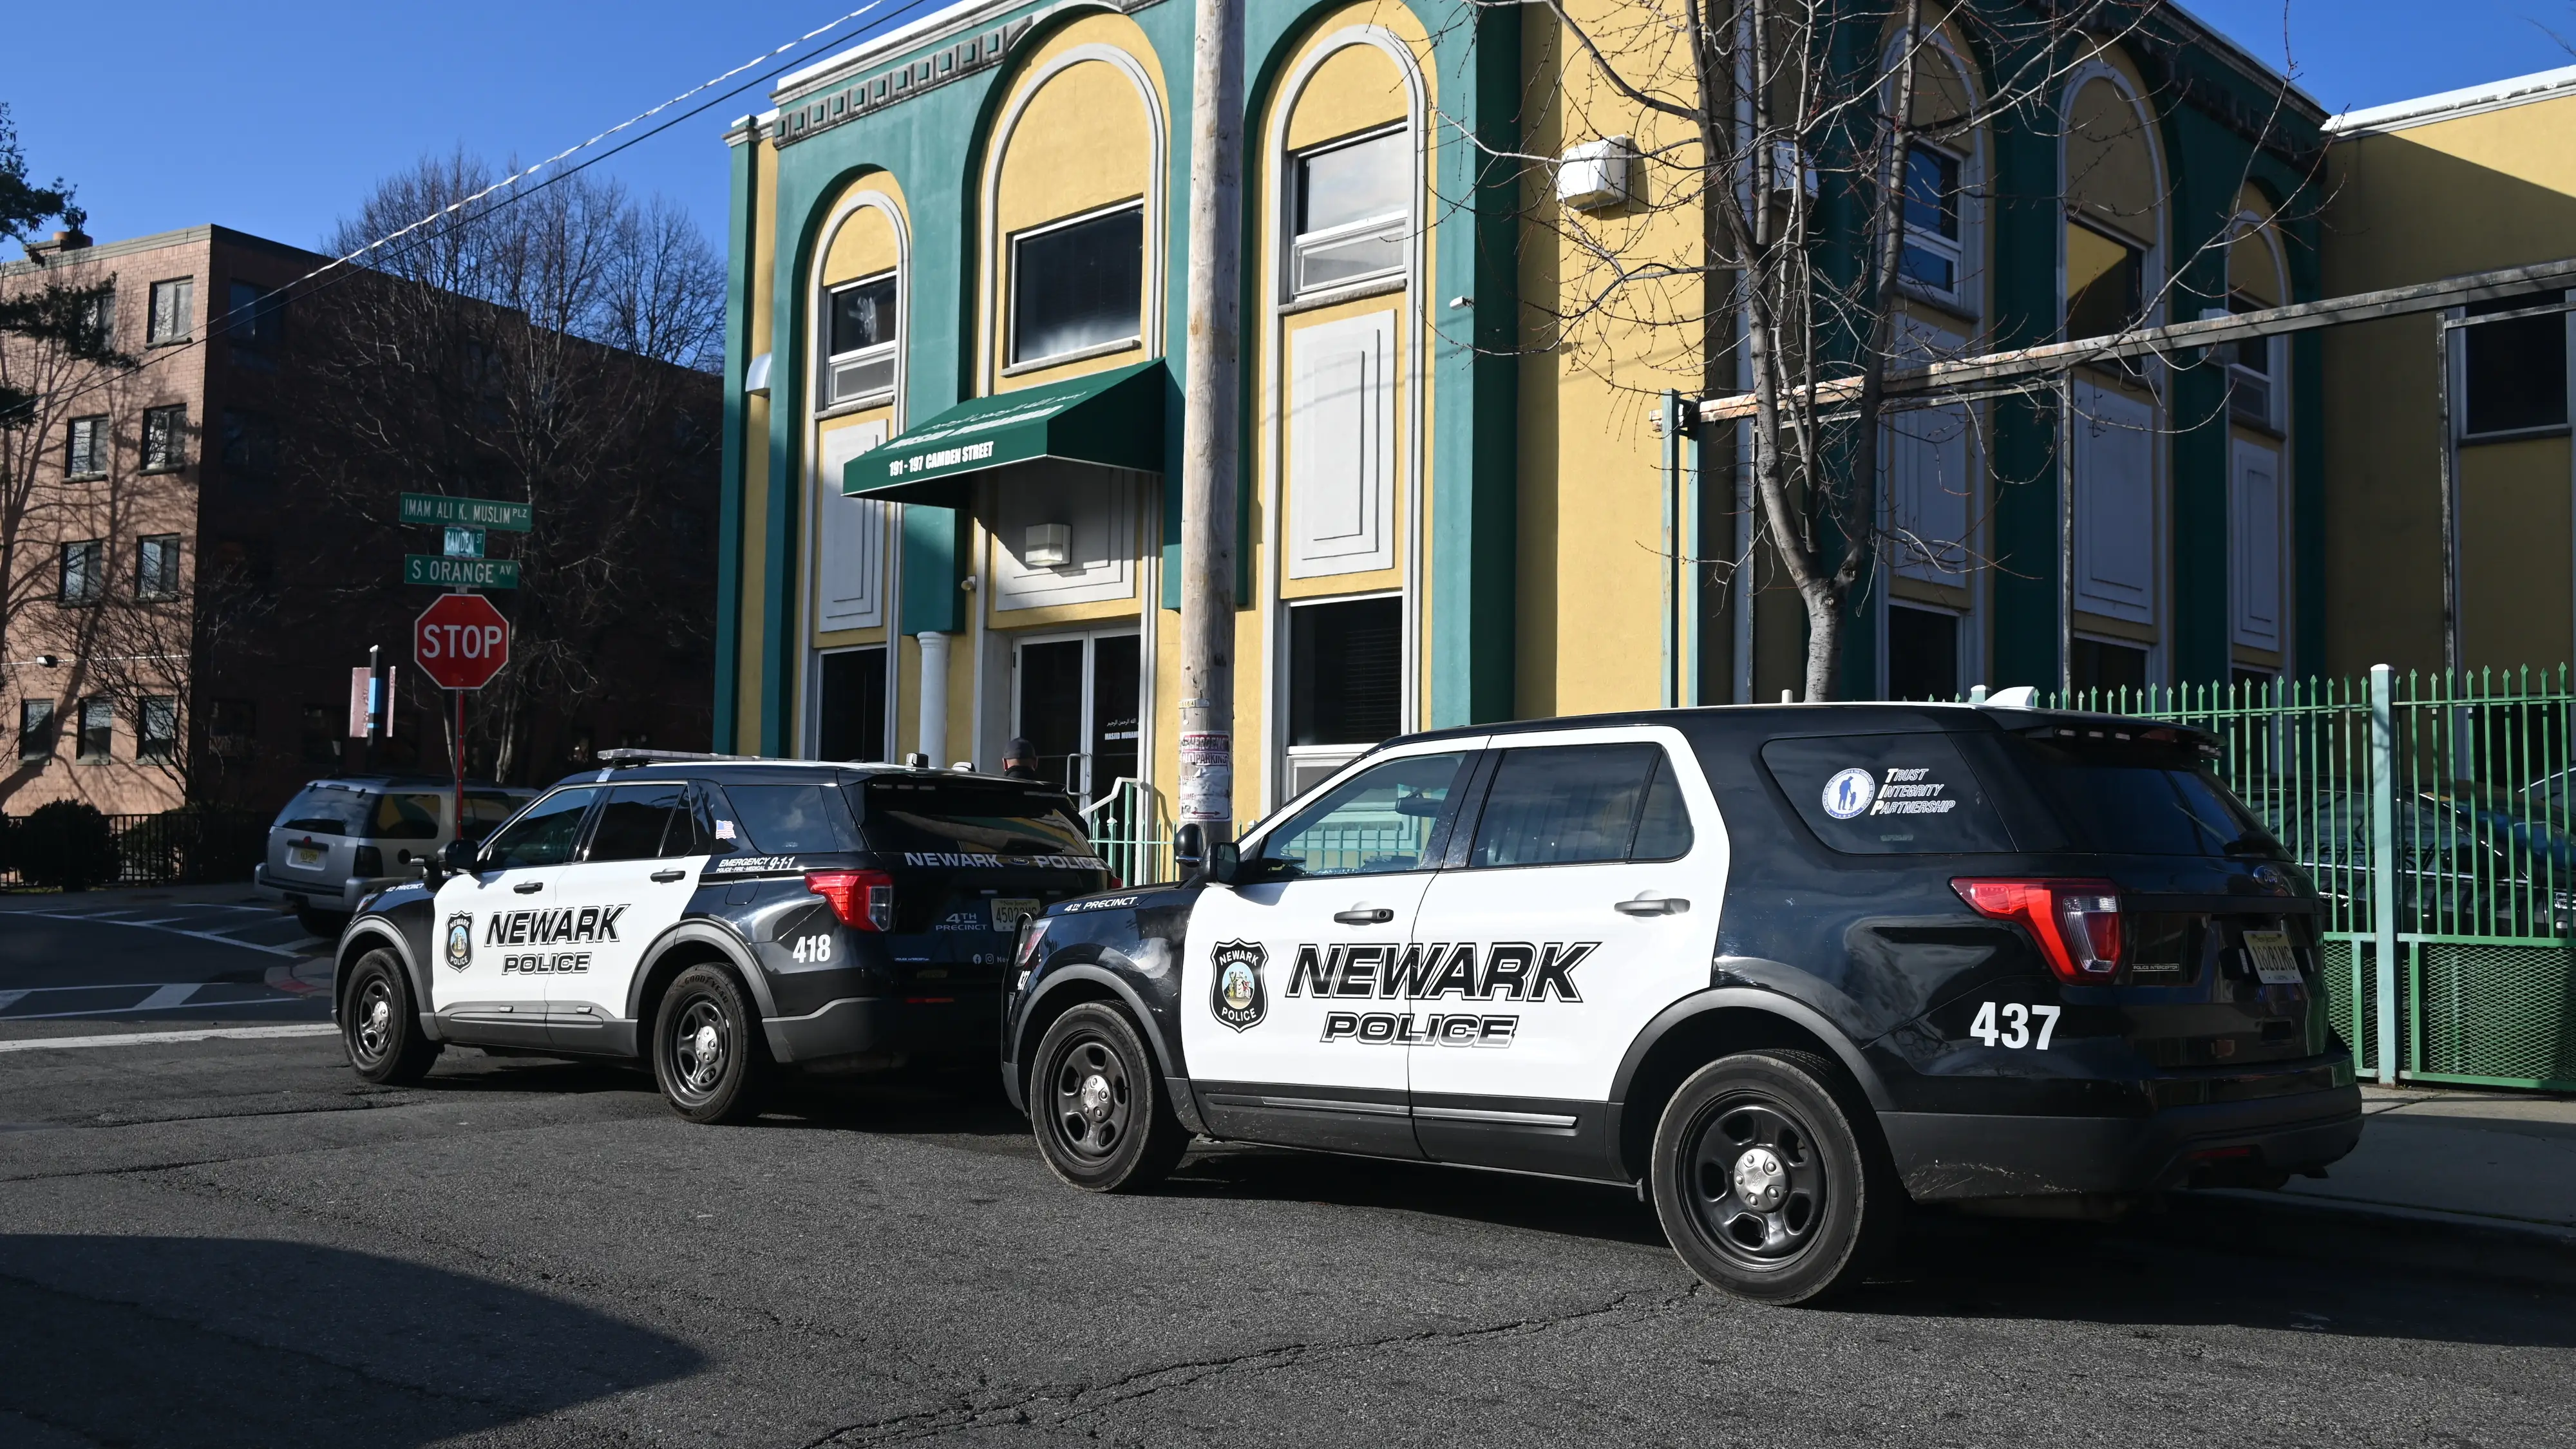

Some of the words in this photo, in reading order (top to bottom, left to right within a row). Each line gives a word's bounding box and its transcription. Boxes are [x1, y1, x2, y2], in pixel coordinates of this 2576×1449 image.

[889, 459, 904, 477] 191
[909, 455, 923, 473] 197
[925, 447, 961, 469] CAMDEN
[961, 440, 994, 462] STREET
[405, 498, 431, 517] IMAM
[437, 502, 453, 519] ALI
[459, 504, 467, 520] K.
[473, 505, 510, 524] MUSLIM
[513, 508, 527, 518] PLZ
[446, 531, 474, 553] CAMDEN
[477, 533, 483, 544] ST
[412, 560, 421, 580] S
[430, 560, 494, 583] ORANGE
[499, 565, 511, 575] AV
[422, 624, 502, 659] STOP
[1196, 753, 1228, 764] PARKING
[1885, 768, 1929, 782] TRUST
[1877, 784, 1944, 799] INTEGRITY
[1870, 800, 1956, 816] PARTNERSHIP
[719, 857, 772, 867] EMERGENCY
[768, 856, 795, 870] 9-1-1
[904, 852, 1004, 867] NEWARK
[1033, 855, 1105, 869] POLICE
[1064, 902, 1081, 912] 4TH
[1083, 896, 1138, 910] PRECINCT
[450, 918, 471, 929] NEWARK
[484, 904, 632, 947] NEWARK
[946, 913, 977, 923] 4TH
[792, 934, 831, 963] 418
[450, 956, 469, 966] POLICE
[502, 952, 592, 975] POLICE
[1219, 950, 1259, 966] NEWARK
[1285, 941, 1604, 1003] NEWARK
[1221, 1007, 1257, 1021] POLICE
[1320, 1011, 1519, 1048] POLICE
[1970, 1001, 2061, 1050] 437
